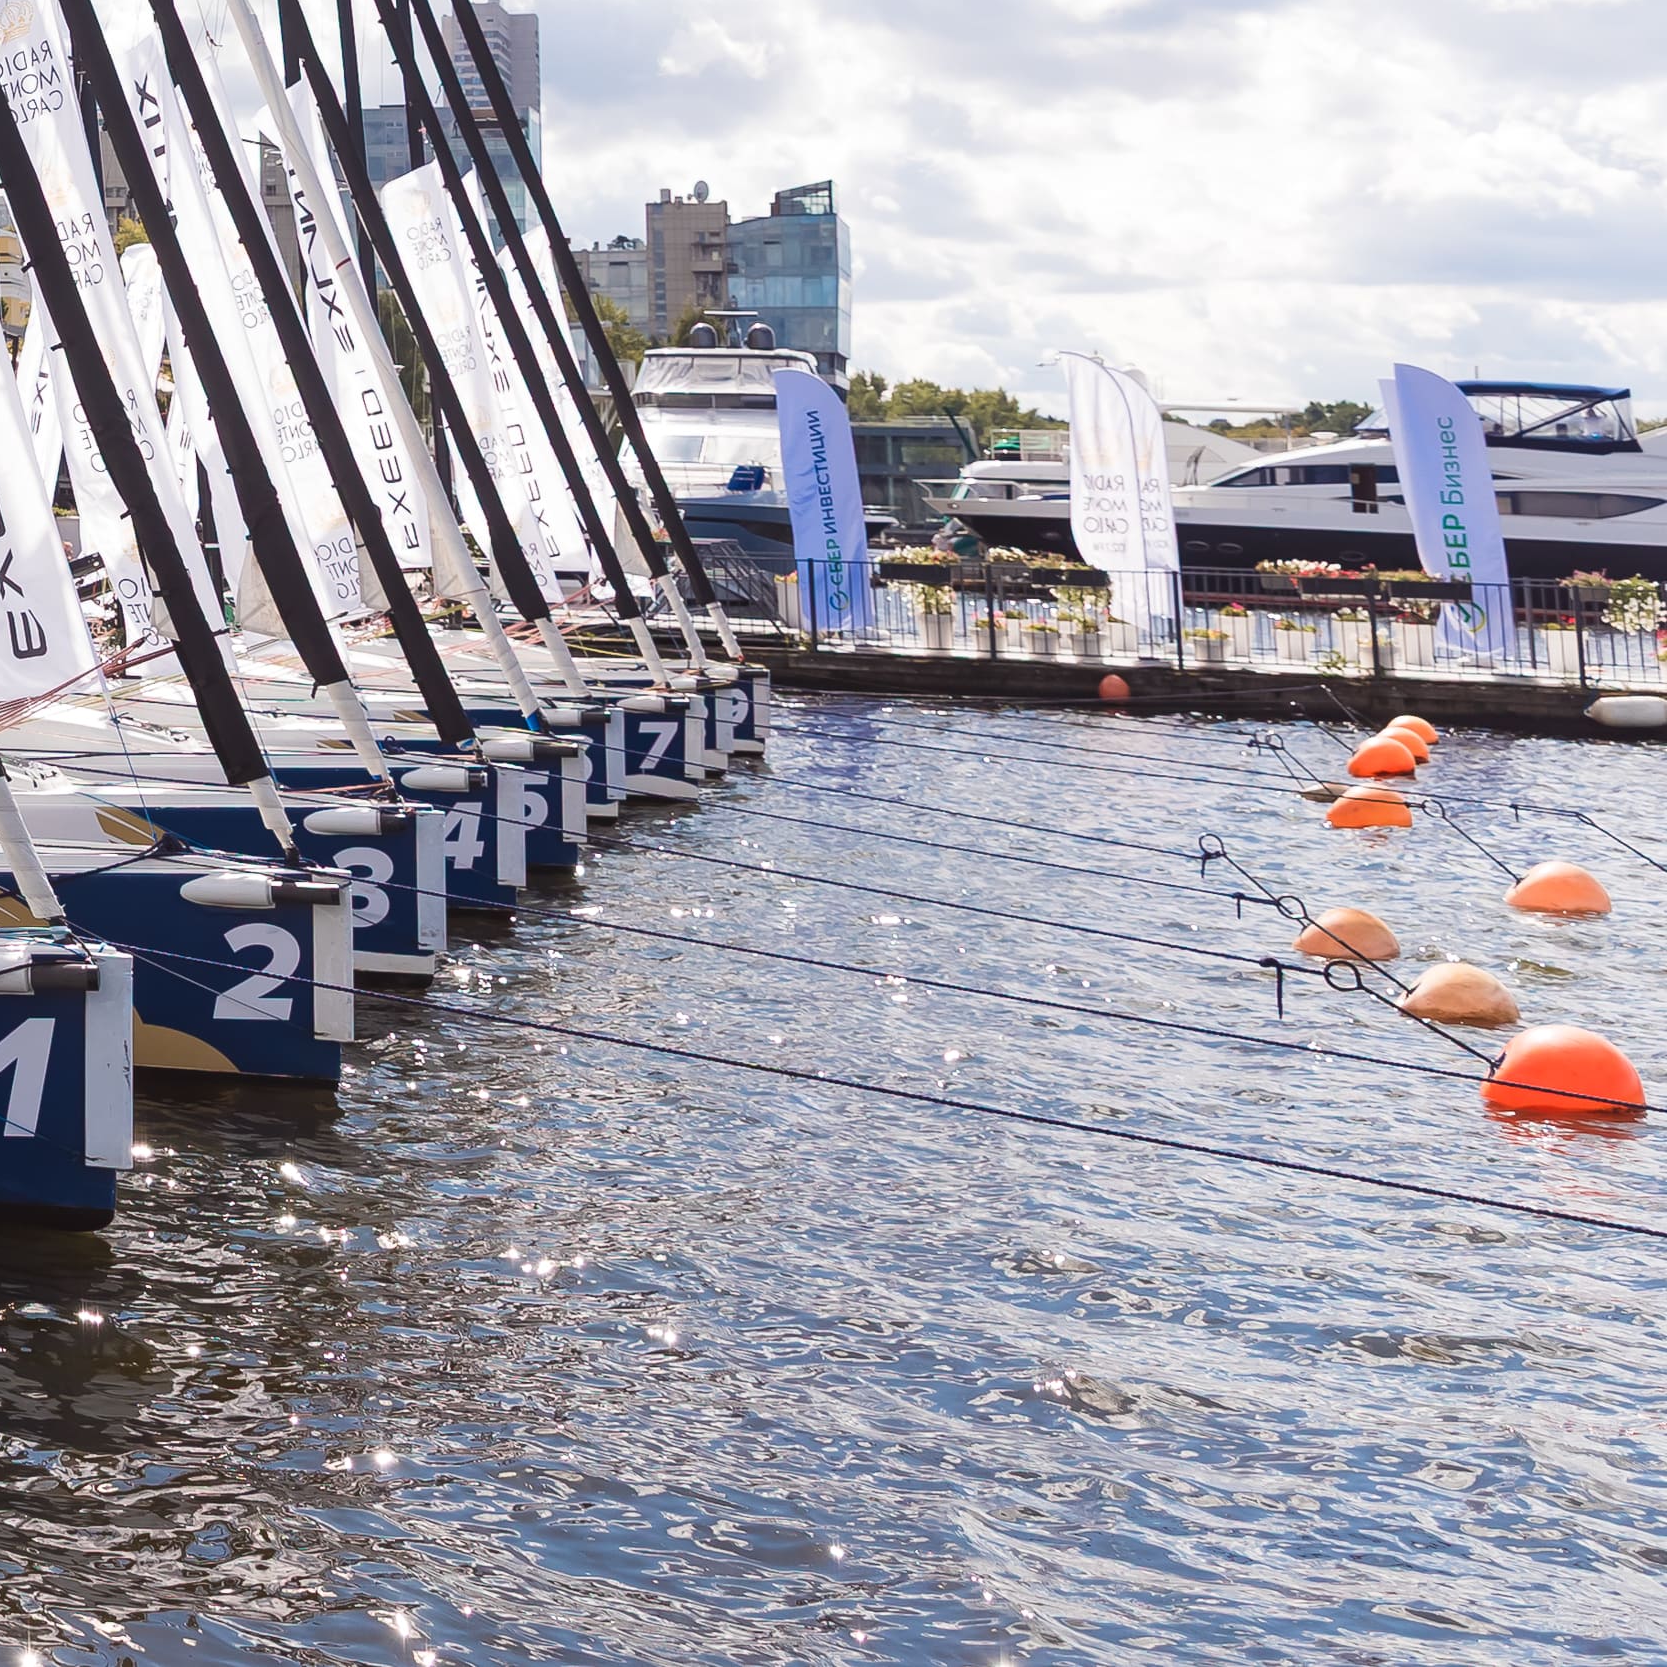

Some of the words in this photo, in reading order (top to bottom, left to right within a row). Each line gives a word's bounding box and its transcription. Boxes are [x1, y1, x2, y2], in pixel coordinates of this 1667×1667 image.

[807, 409, 836, 535] ИНВЕСТИЦИИ
[1437, 415, 1464, 506] Бизнес
[638, 721, 679, 770] 7
[444, 801, 486, 869] 4
[331, 845, 395, 928] 3
[212, 922, 301, 1021] 2
